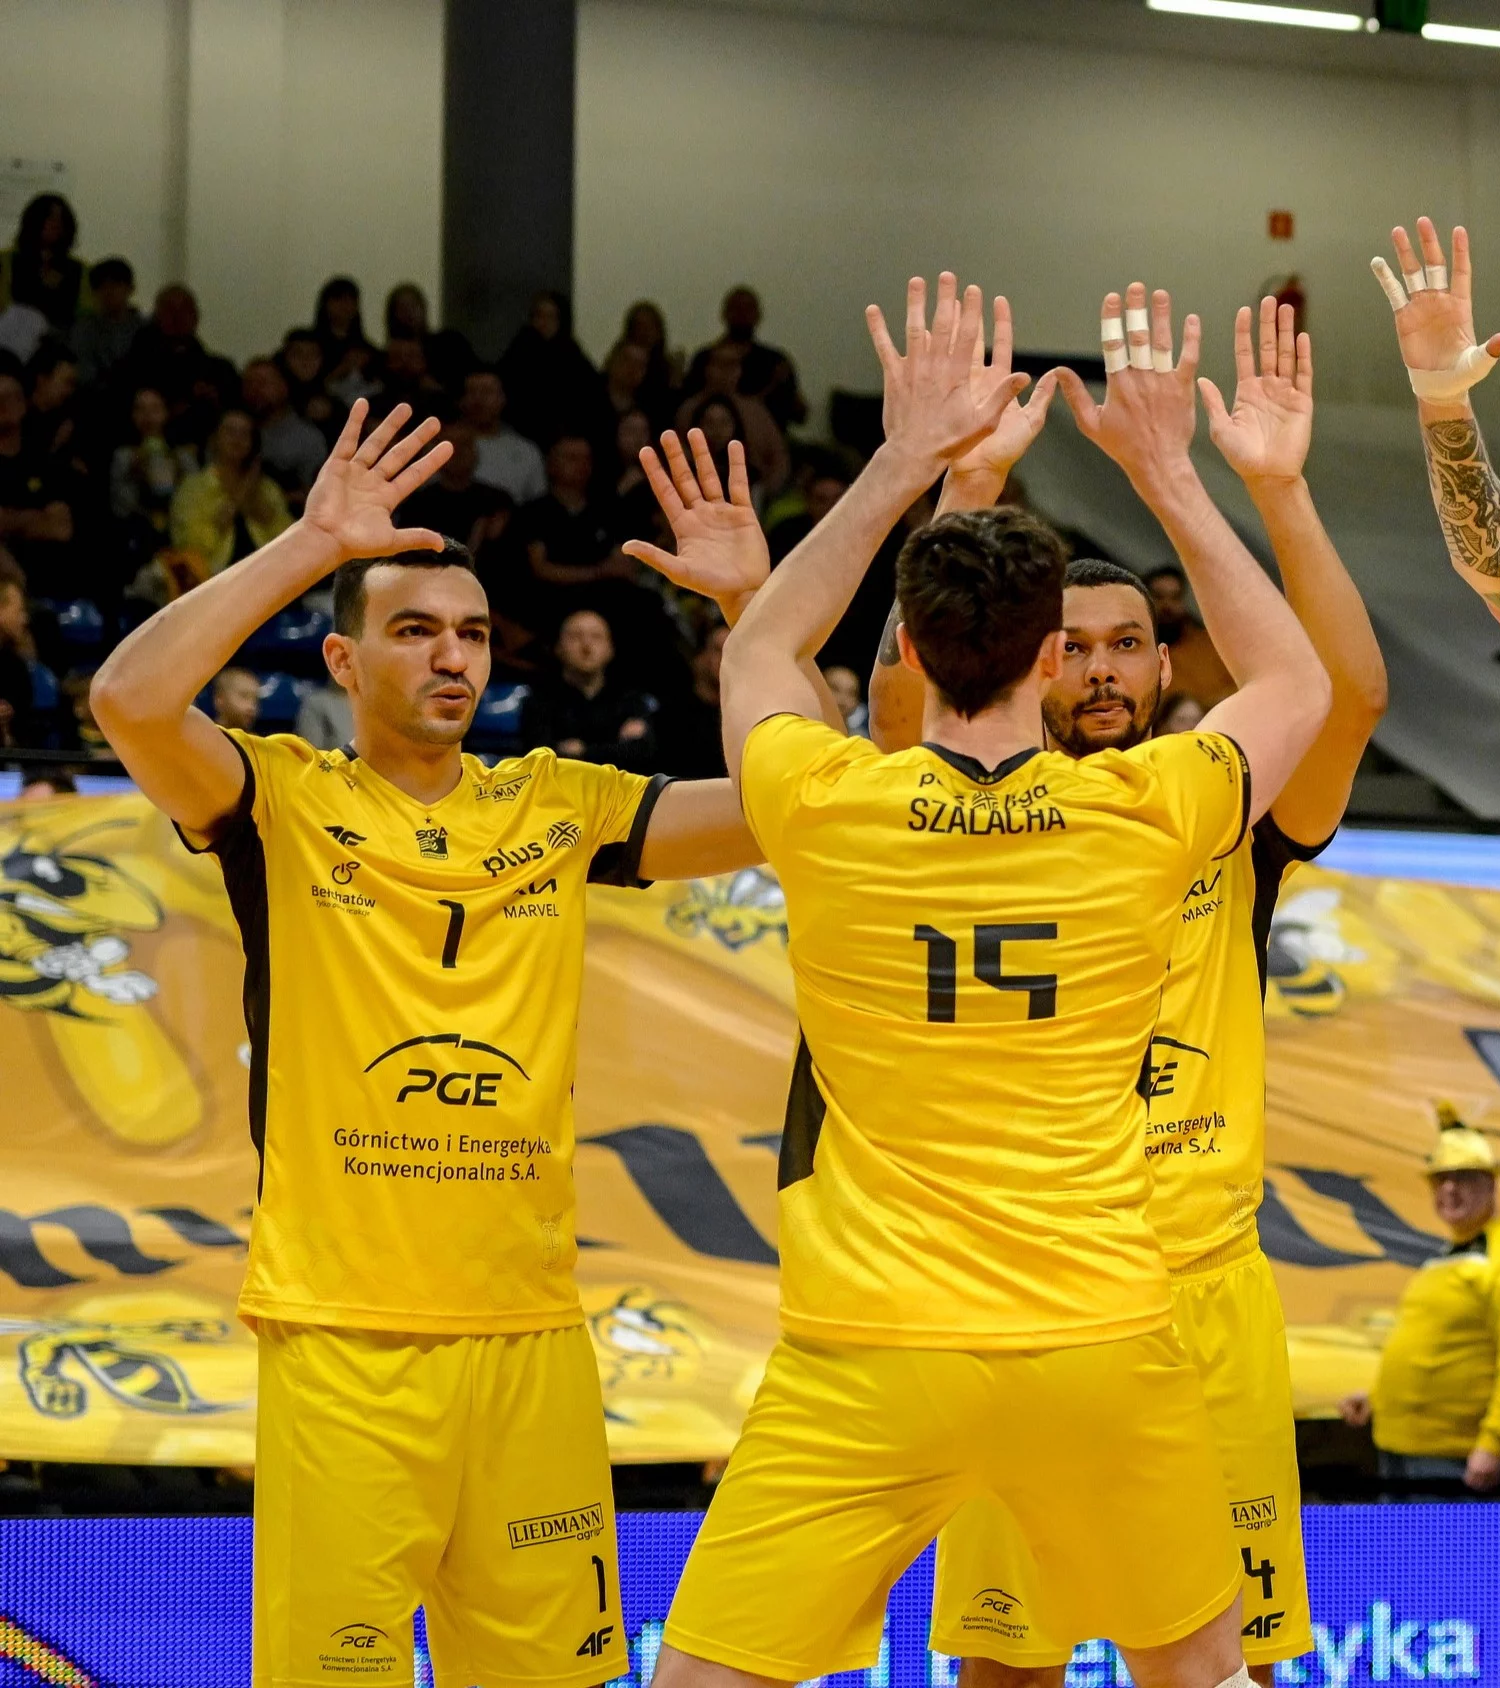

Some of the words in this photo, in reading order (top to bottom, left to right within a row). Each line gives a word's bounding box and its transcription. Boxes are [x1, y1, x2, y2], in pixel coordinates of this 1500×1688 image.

[908, 797, 1066, 836] SZALACHA
[482, 841, 545, 878] plus
[503, 903, 560, 919] MARVEL
[438, 899, 466, 969] 1
[913, 922, 1058, 1023] 15
[396, 1068, 503, 1107] PGE
[334, 1128, 439, 1151] Górnictwo
[446, 1134, 451, 1151] i
[459, 1135, 551, 1158] Energetyka
[344, 1156, 505, 1184] Konwencjonalna
[509, 1163, 540, 1181] S.A.
[513, 1508, 601, 1543] LIEDMANN
[591, 1554, 606, 1614] 1
[1241, 1547, 1275, 1599] 4
[981, 1598, 1013, 1614] PGE
[340, 1635, 377, 1648] PGE
[576, 1625, 615, 1657] 4F
[1241, 1611, 1285, 1639] 4F
